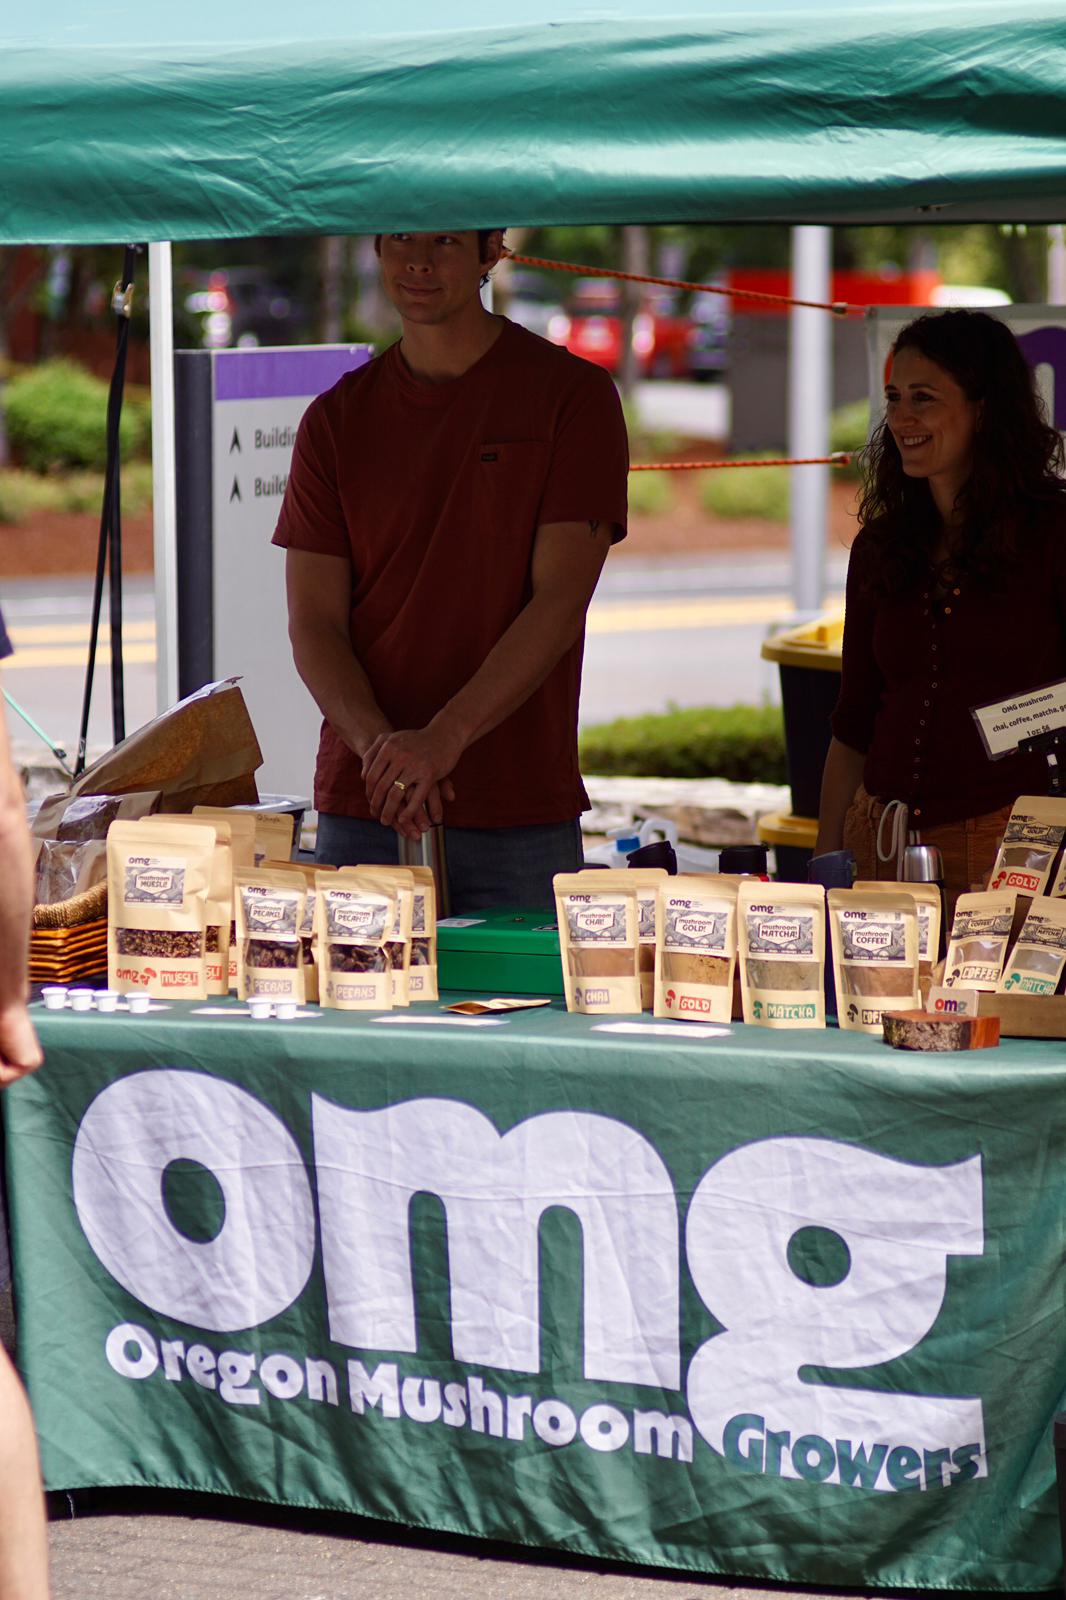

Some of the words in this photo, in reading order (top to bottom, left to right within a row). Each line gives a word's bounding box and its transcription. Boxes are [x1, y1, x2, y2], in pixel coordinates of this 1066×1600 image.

[1001, 704, 1018, 714] OMG
[1018, 693, 1054, 709] mushroom
[992, 723, 1009, 732] chai,
[1008, 716, 1033, 727] coffee,
[1032, 706, 1060, 720] matcha,
[1010, 814, 1028, 823] omg
[128, 857, 151, 866] omg
[1007, 874, 1040, 891] GOLD
[247, 886, 267, 897] omg
[329, 891, 352, 901] omg
[569, 894, 591, 903] omg
[669, 899, 692, 909] omg
[750, 904, 775, 914] omg
[843, 911, 868, 920] omg
[1027, 915, 1044, 923] omg
[761, 930, 799, 938] MATCHA!
[856, 936, 888, 945] COFFEE!
[116, 968, 139, 984] omg
[161, 971, 199, 985] MUESLI
[963, 967, 999, 981] COFFEE
[254, 981, 292, 993] PECANS
[336, 986, 376, 999] PECANS
[681, 999, 710, 1010] GOLD
[935, 998, 967, 1013] omg
[768, 1006, 814, 1017] MATCHA
[73, 1069, 984, 1489] omg
[105, 1323, 339, 1406] Oregon
[347, 1358, 694, 1464] Mushroom
[722, 1413, 985, 1492] Growers
